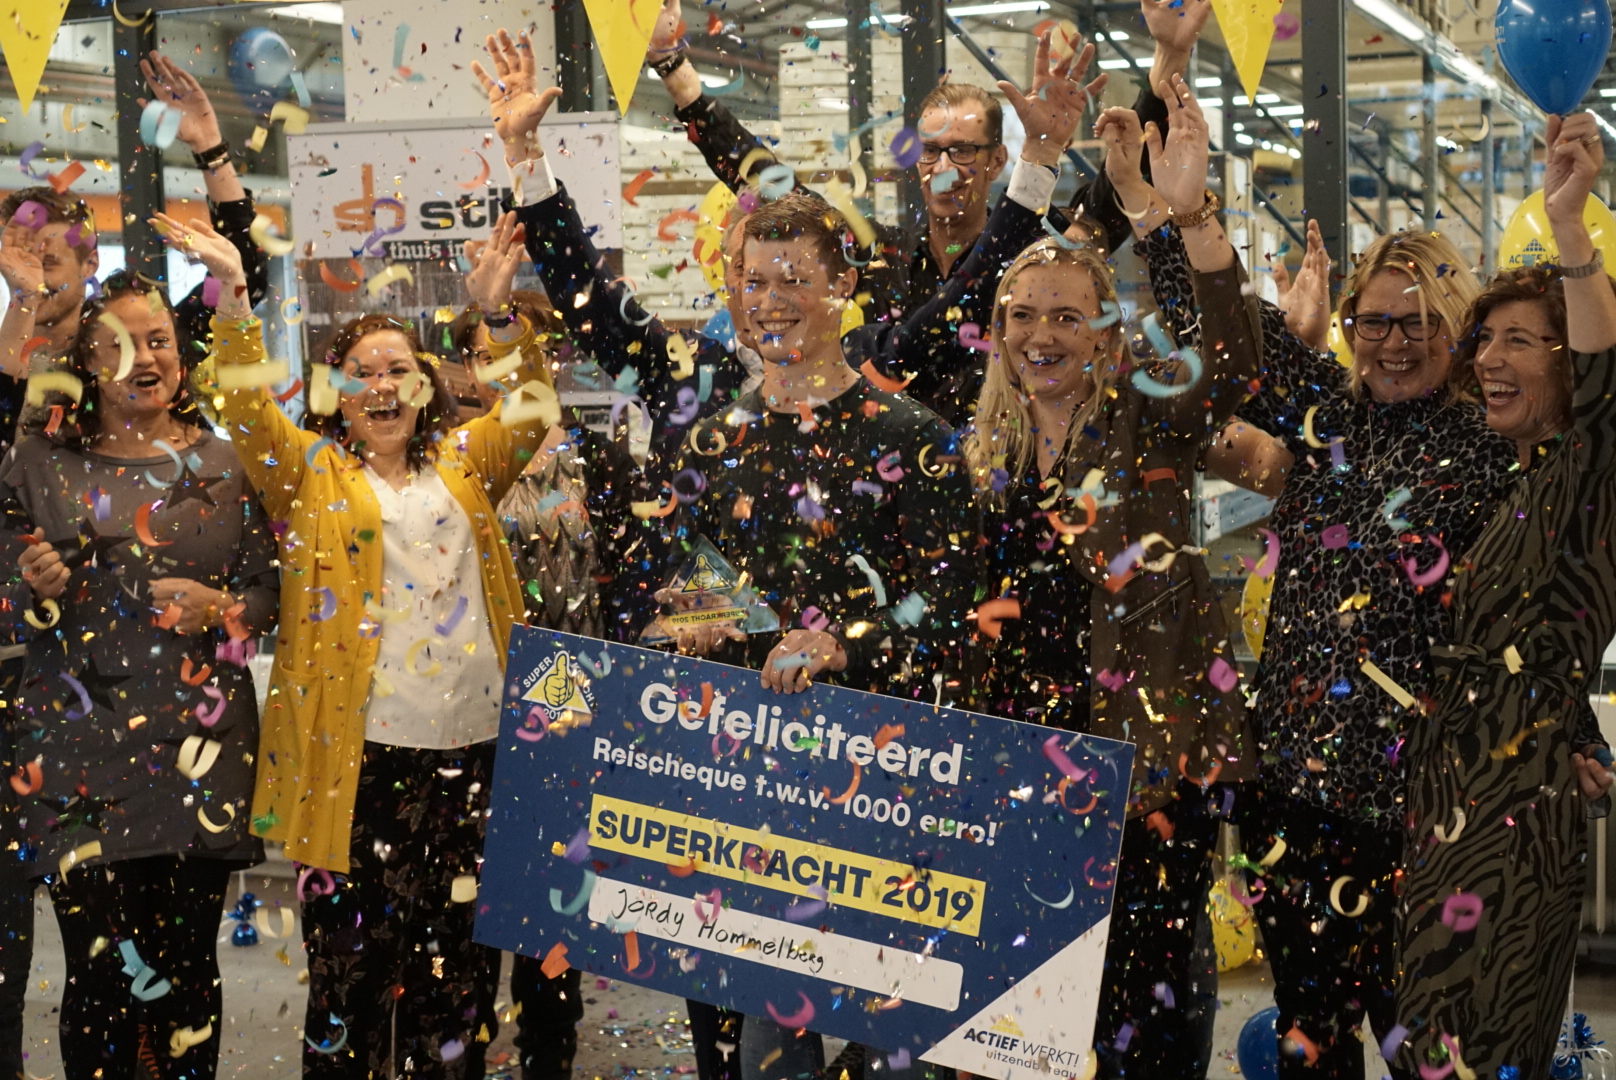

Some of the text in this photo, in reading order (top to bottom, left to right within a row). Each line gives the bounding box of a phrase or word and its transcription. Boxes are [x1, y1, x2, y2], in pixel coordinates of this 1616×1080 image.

[390, 241, 441, 259] thuis
[523, 656, 553, 688] SUPER
[641, 683, 963, 785] Gefeliciteerd
[593, 737, 997, 846] Reischeque t.w.v. 1000 euro!
[596, 809, 974, 922] SUPERKRACHT 2019
[963, 1028, 1019, 1051] ACTIEF
[986, 1050, 1077, 1078] uitzendbreau
